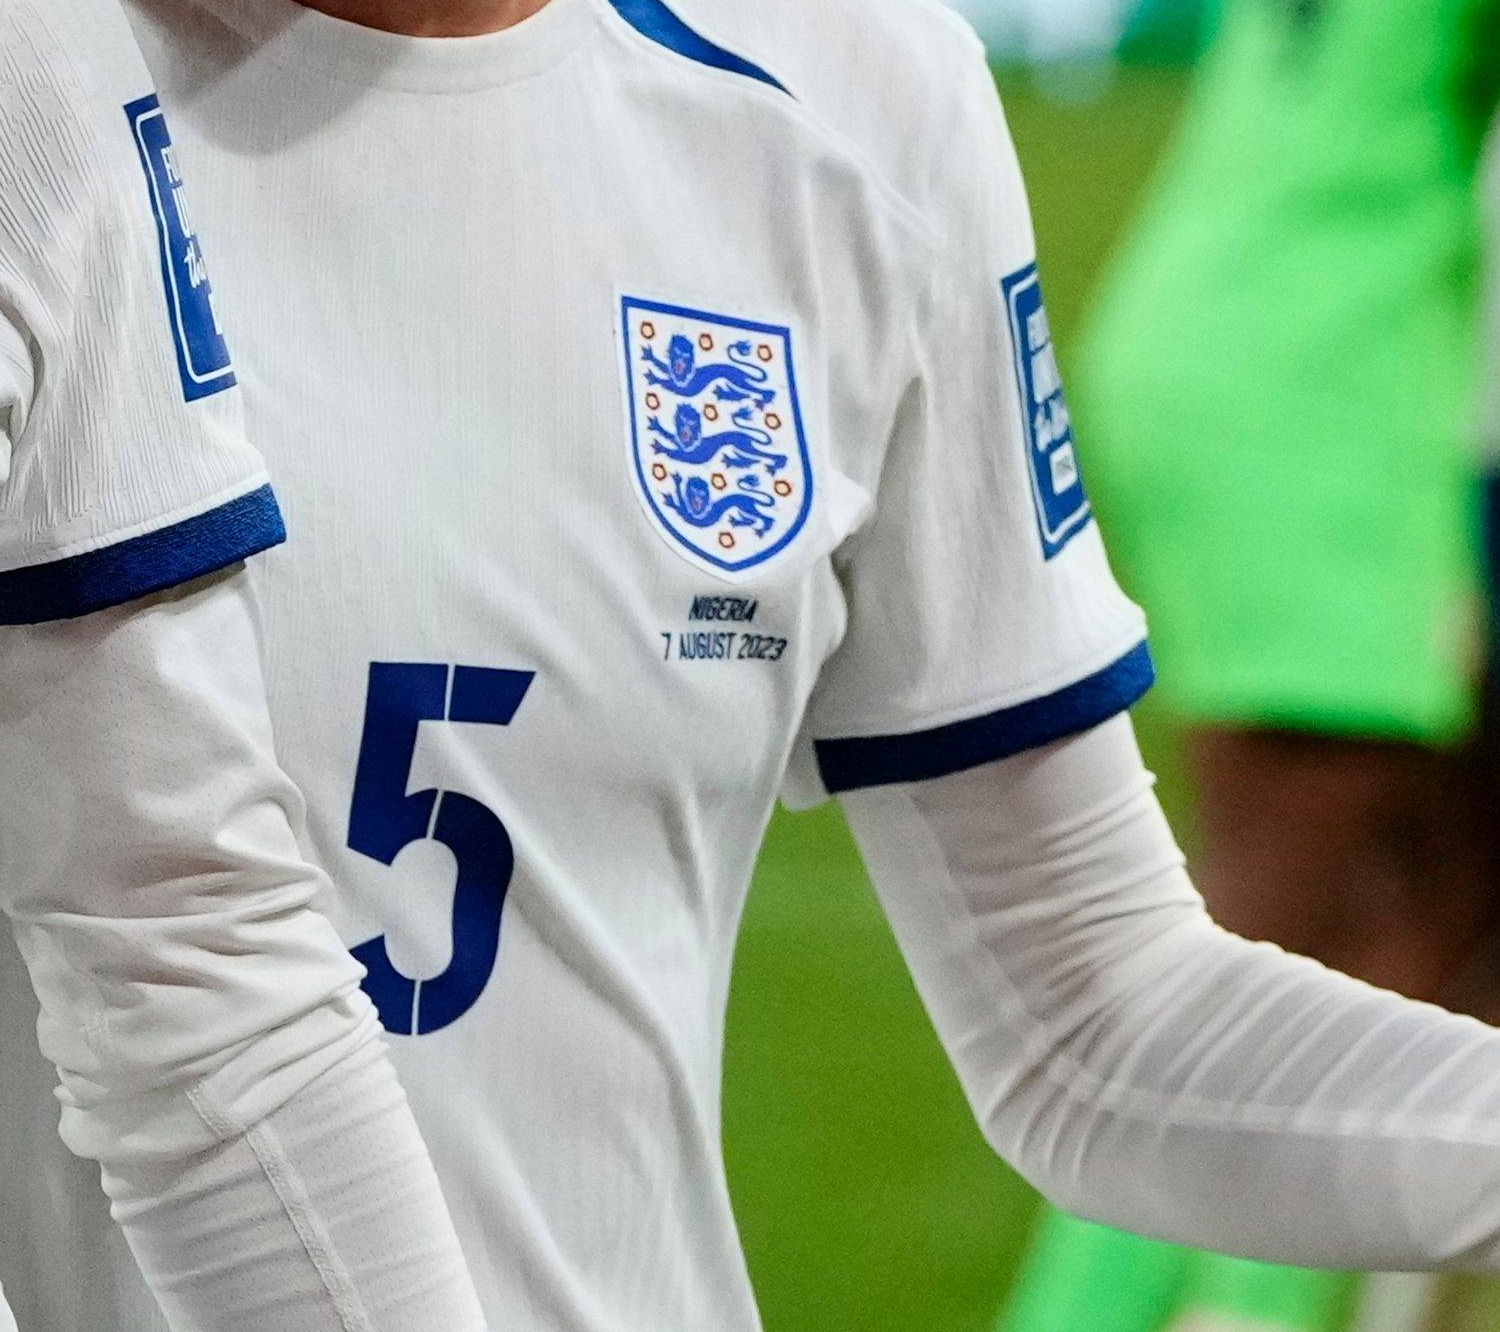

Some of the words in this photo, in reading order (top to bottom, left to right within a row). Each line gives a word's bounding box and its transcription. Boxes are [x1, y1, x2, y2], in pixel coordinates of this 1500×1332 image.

[688, 594, 760, 622] NIGERIA
[661, 631, 672, 661] 7
[679, 631, 737, 659] AUGUST
[737, 632, 788, 661] 2023
[346, 660, 537, 1036] 5
